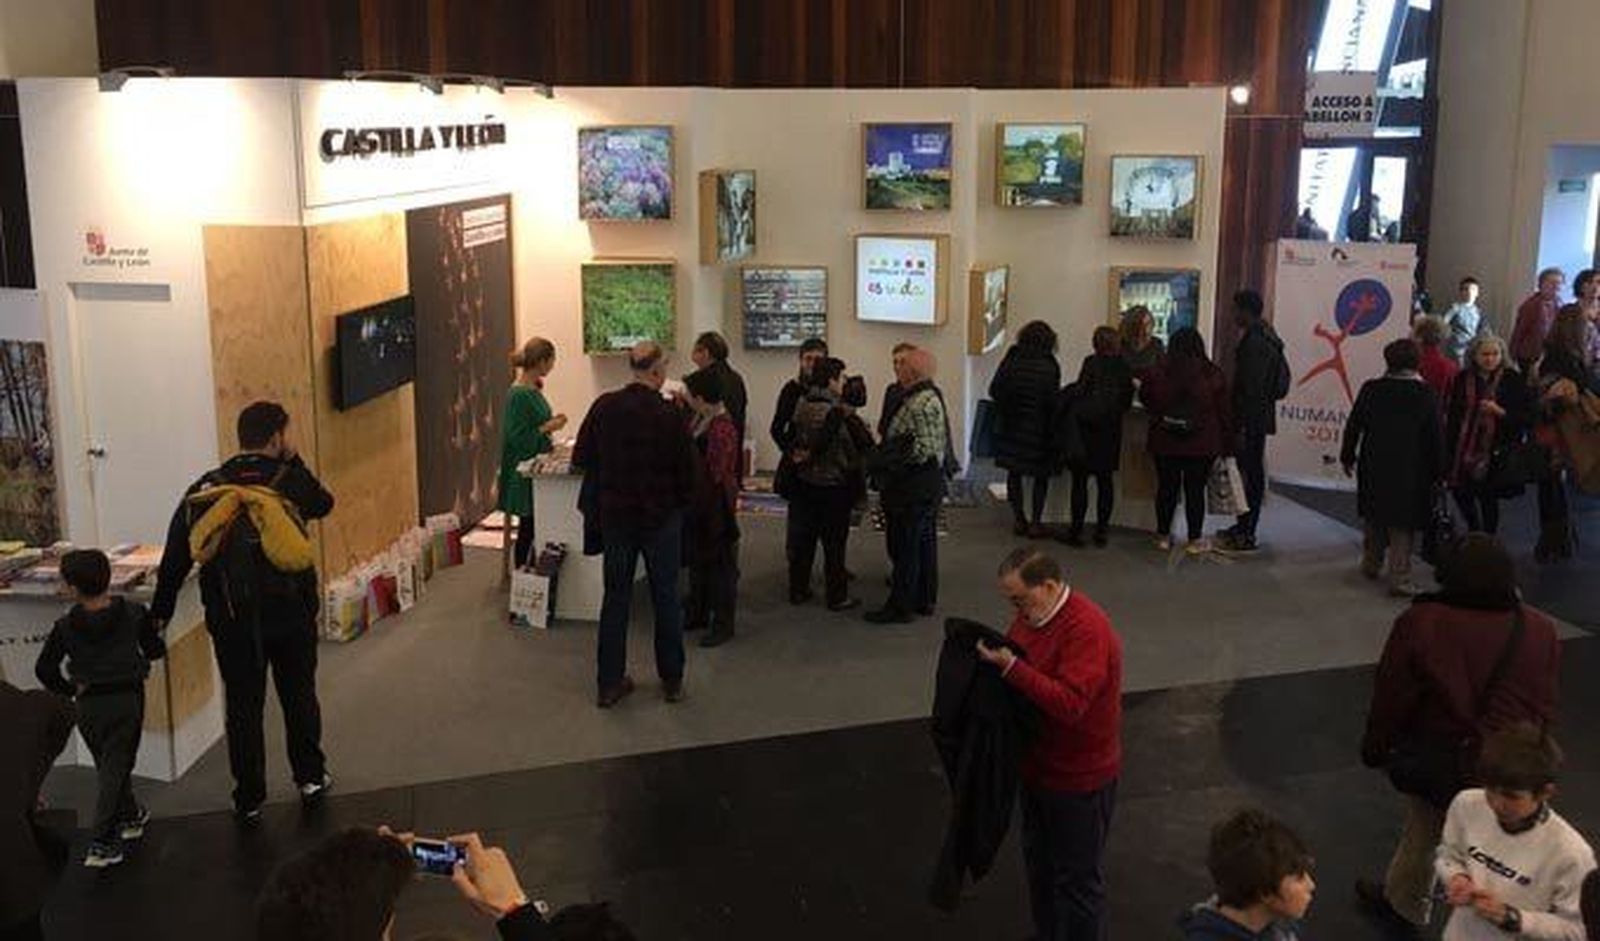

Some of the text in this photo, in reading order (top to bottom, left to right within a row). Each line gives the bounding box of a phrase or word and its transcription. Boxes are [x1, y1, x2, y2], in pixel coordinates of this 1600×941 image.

[1312, 95, 1374, 108] ACCESO A
[1303, 110, 1374, 122] ABELLON 2
[320, 114, 507, 158] CASTILLA Y LEÓN
[1280, 404, 1346, 424] NUMAN
[1306, 426, 1339, 443] 201
